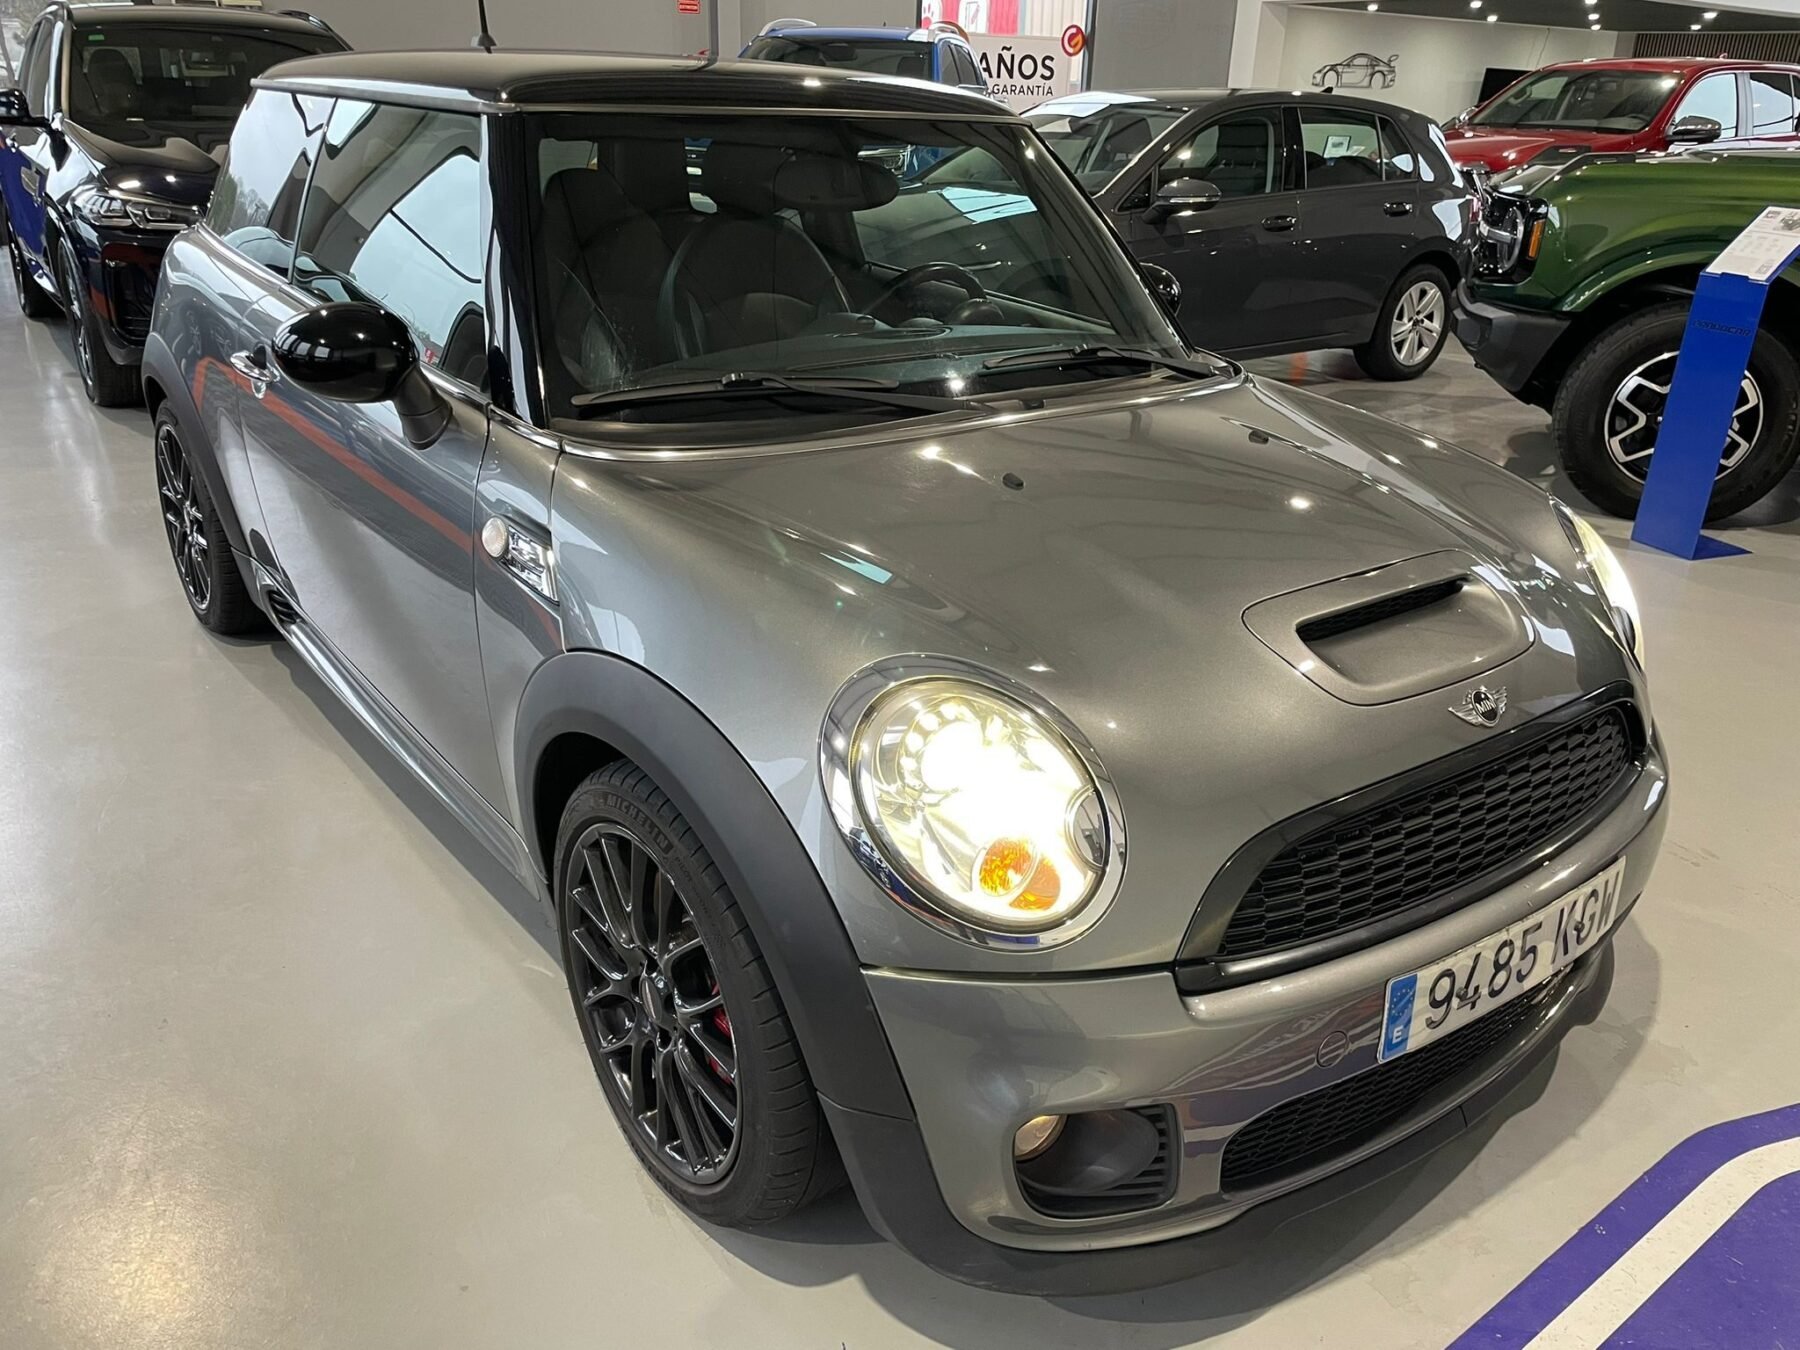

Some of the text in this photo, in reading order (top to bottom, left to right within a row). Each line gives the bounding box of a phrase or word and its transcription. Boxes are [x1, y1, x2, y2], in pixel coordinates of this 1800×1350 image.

[979, 46, 1055, 81] AÑOS
[992, 83, 1053, 96] GARANTÍA
[1475, 699, 1496, 714] MINI
[606, 794, 669, 849] MICHELIN
[1425, 871, 1620, 1030] 9485 KGW
[1392, 1026, 1402, 1043] E
